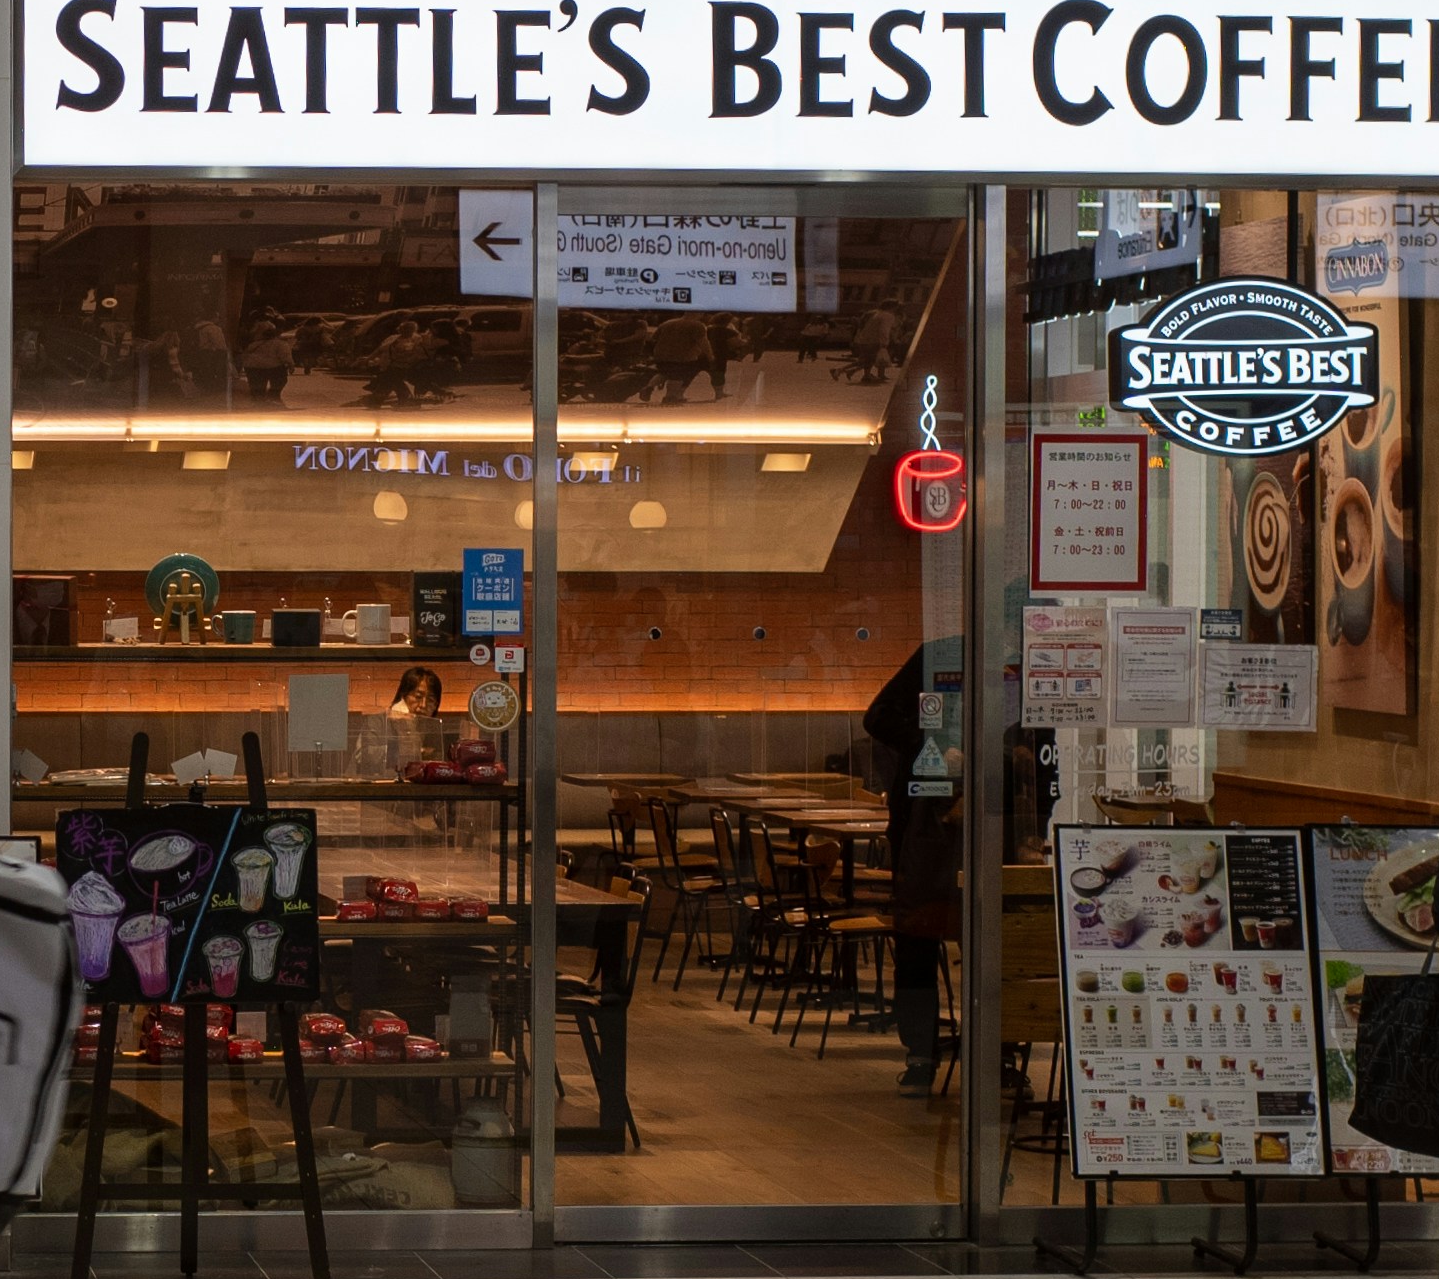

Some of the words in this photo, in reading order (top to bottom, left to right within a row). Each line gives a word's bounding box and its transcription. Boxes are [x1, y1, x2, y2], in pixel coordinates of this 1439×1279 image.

[707, 0, 1006, 119] BEST
[1160, 311, 1190, 338] BOLD
[1190, 293, 1238, 316] FLAVOR
[1246, 291, 1298, 314] SMOOTH
[1299, 303, 1335, 338] TASTE
[1128, 345, 1282, 389] SEATTLE'S
[1287, 346, 1368, 386] BEST
[1175, 407, 1323, 446] COFFEE
[1048, 452, 1133, 462] 営業時間のお知らせ
[1054, 526, 1125, 537] 金・土・祝前日
[476, 584, 510, 592] クーポン
[1040, 743, 1135, 766] OPERATING
[1142, 744, 1200, 765] HOURS
[1069, 839, 1090, 861] 芋
[1330, 847, 1388, 861] LUNCH
[177, 871, 191, 883] hot
[211, 894, 238, 908] Soda
[282, 900, 311, 914] Kula
